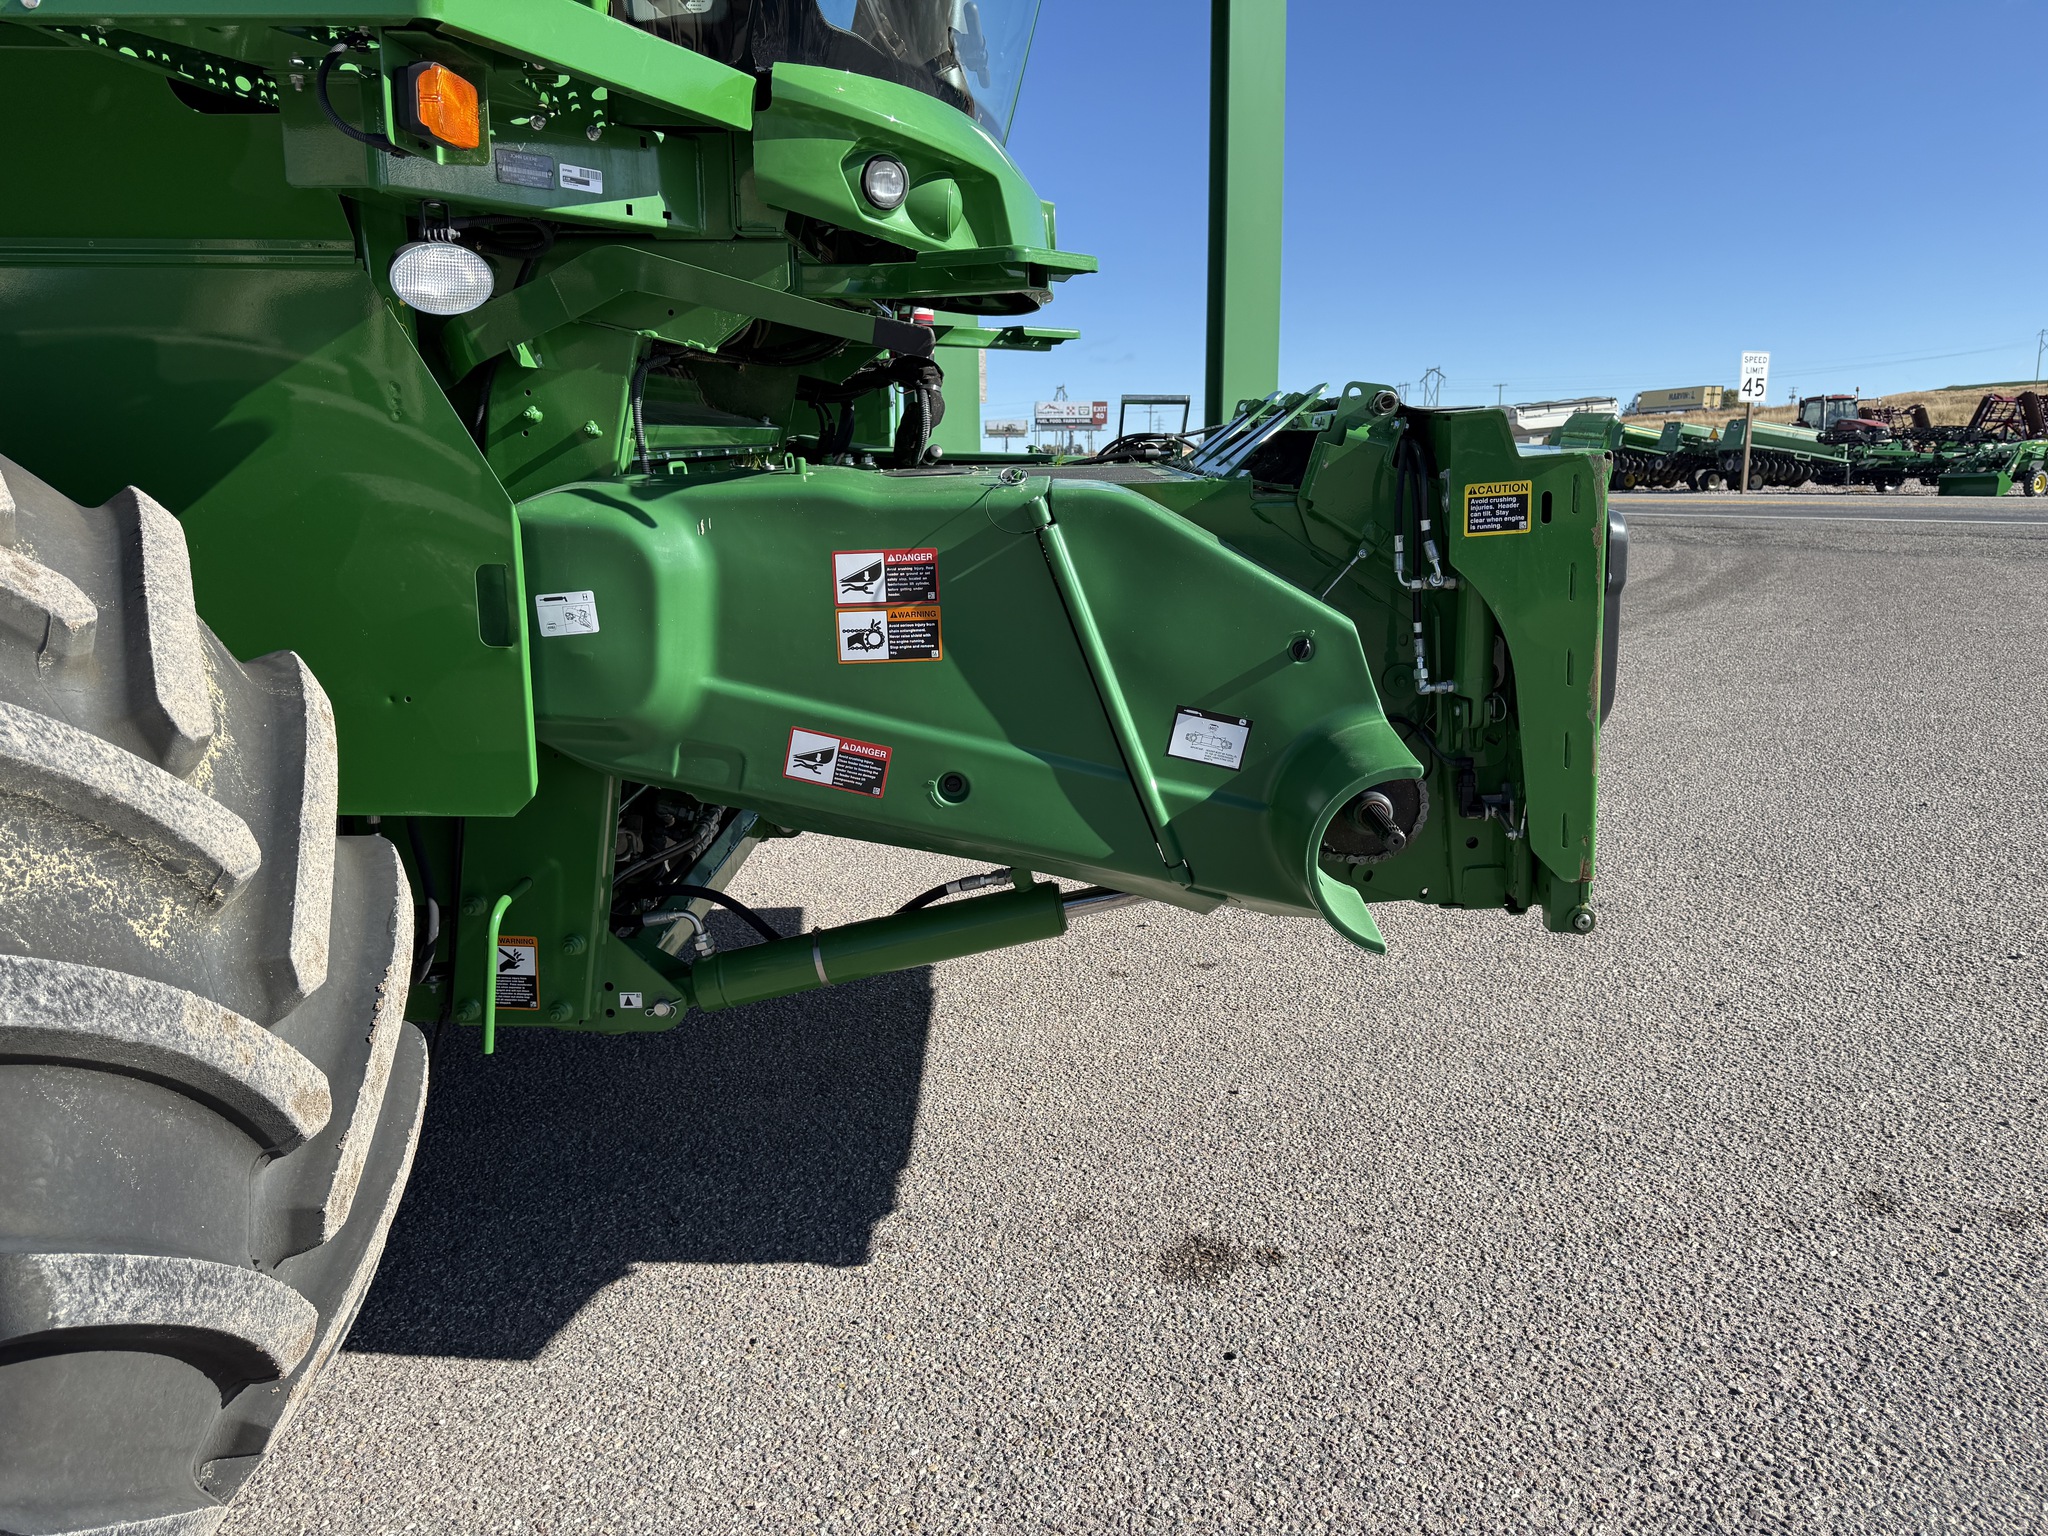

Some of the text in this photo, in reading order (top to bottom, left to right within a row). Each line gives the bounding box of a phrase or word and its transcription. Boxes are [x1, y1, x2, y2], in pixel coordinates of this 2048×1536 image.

[1742, 377, 1764, 397] 45
[1478, 483, 1528, 494] CAUTION
[896, 553, 932, 561] DANGER
[850, 744, 886, 758] DANGER
